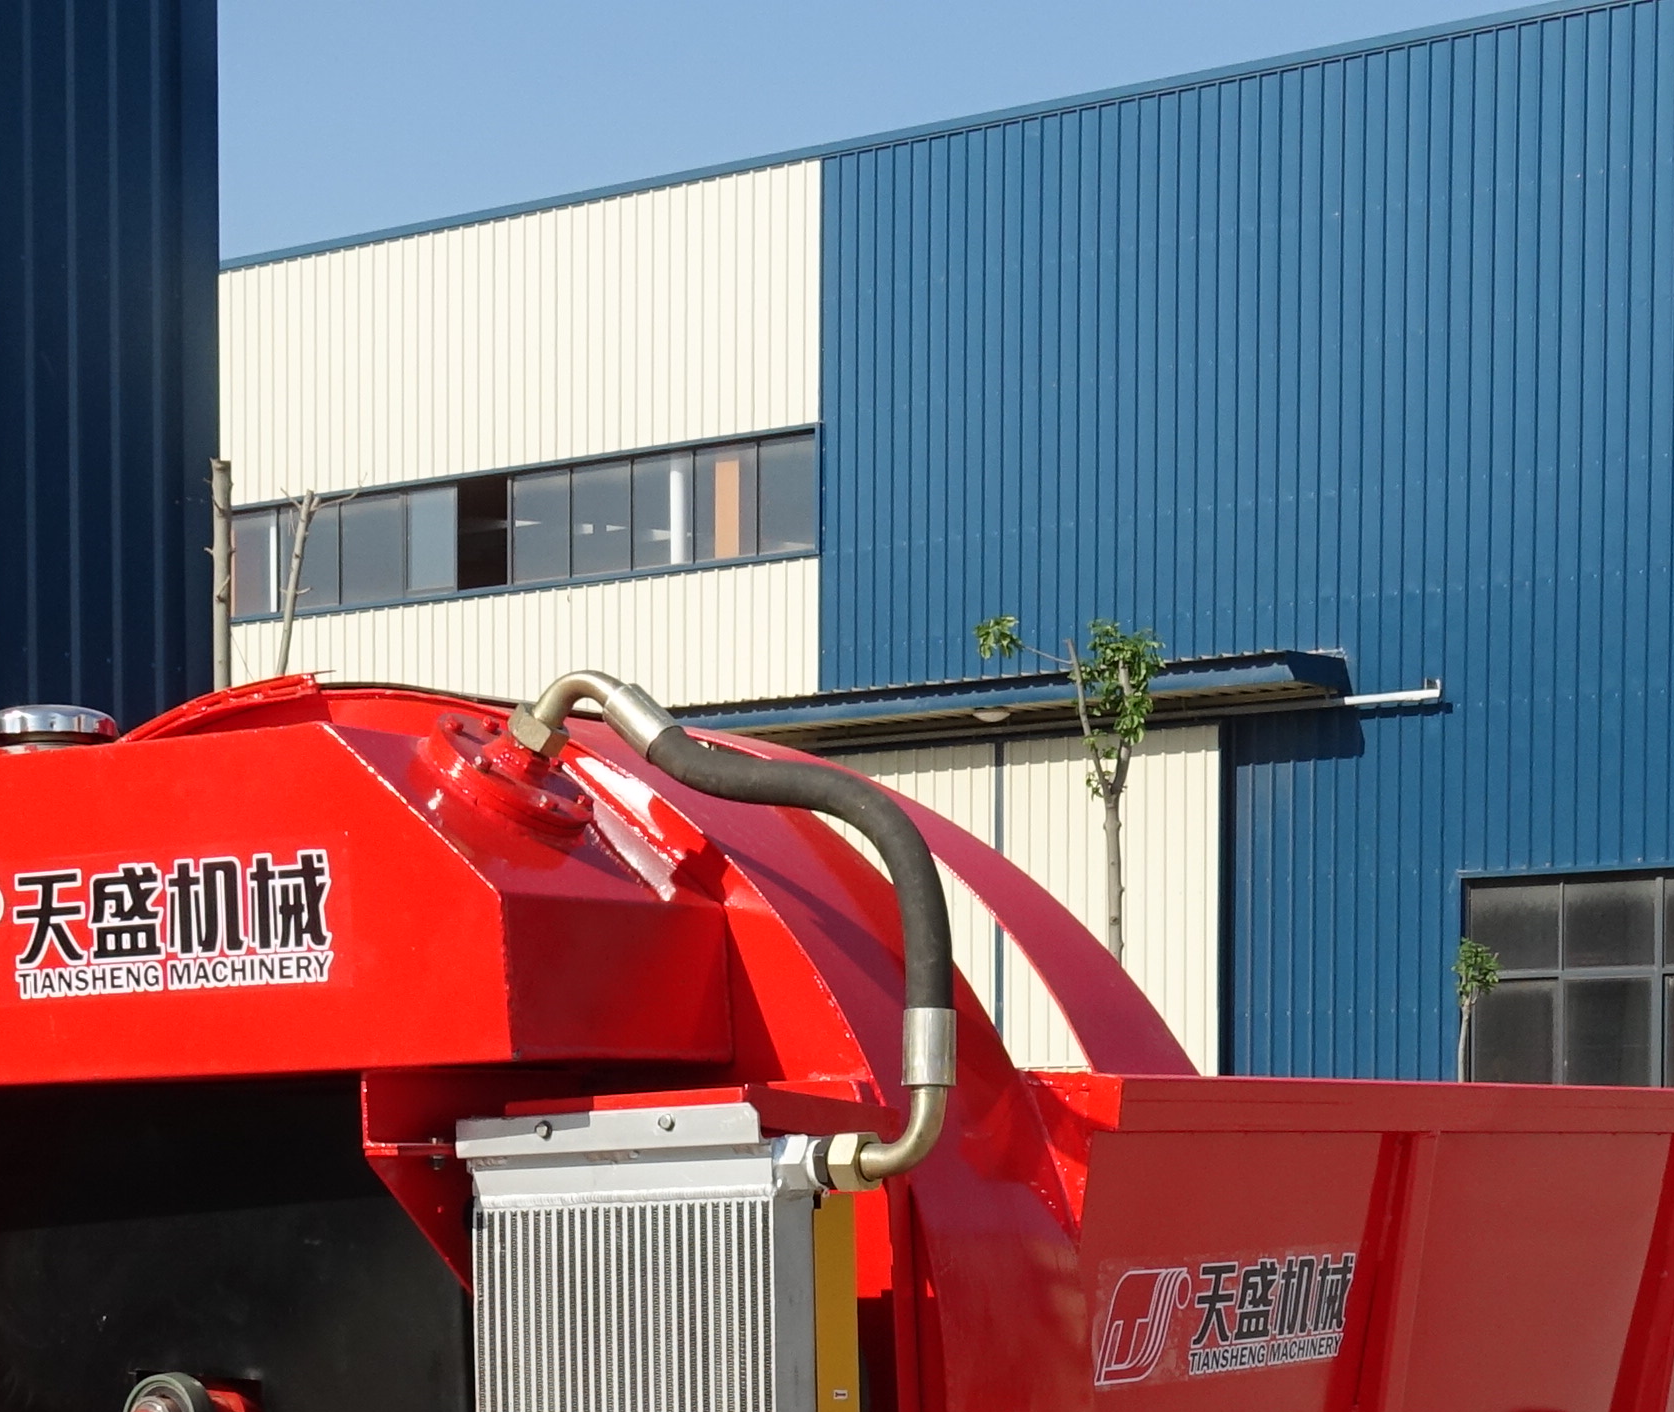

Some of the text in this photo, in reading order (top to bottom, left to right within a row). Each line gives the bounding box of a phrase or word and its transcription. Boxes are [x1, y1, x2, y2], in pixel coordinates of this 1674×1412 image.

[14, 848, 332, 970] 天盛机械
[17, 952, 334, 999] TIANSHENG MACHINERY
[1191, 1253, 1355, 1347] 天盛机械
[1189, 1333, 1344, 1375] TIANSHENG MACHINERY
